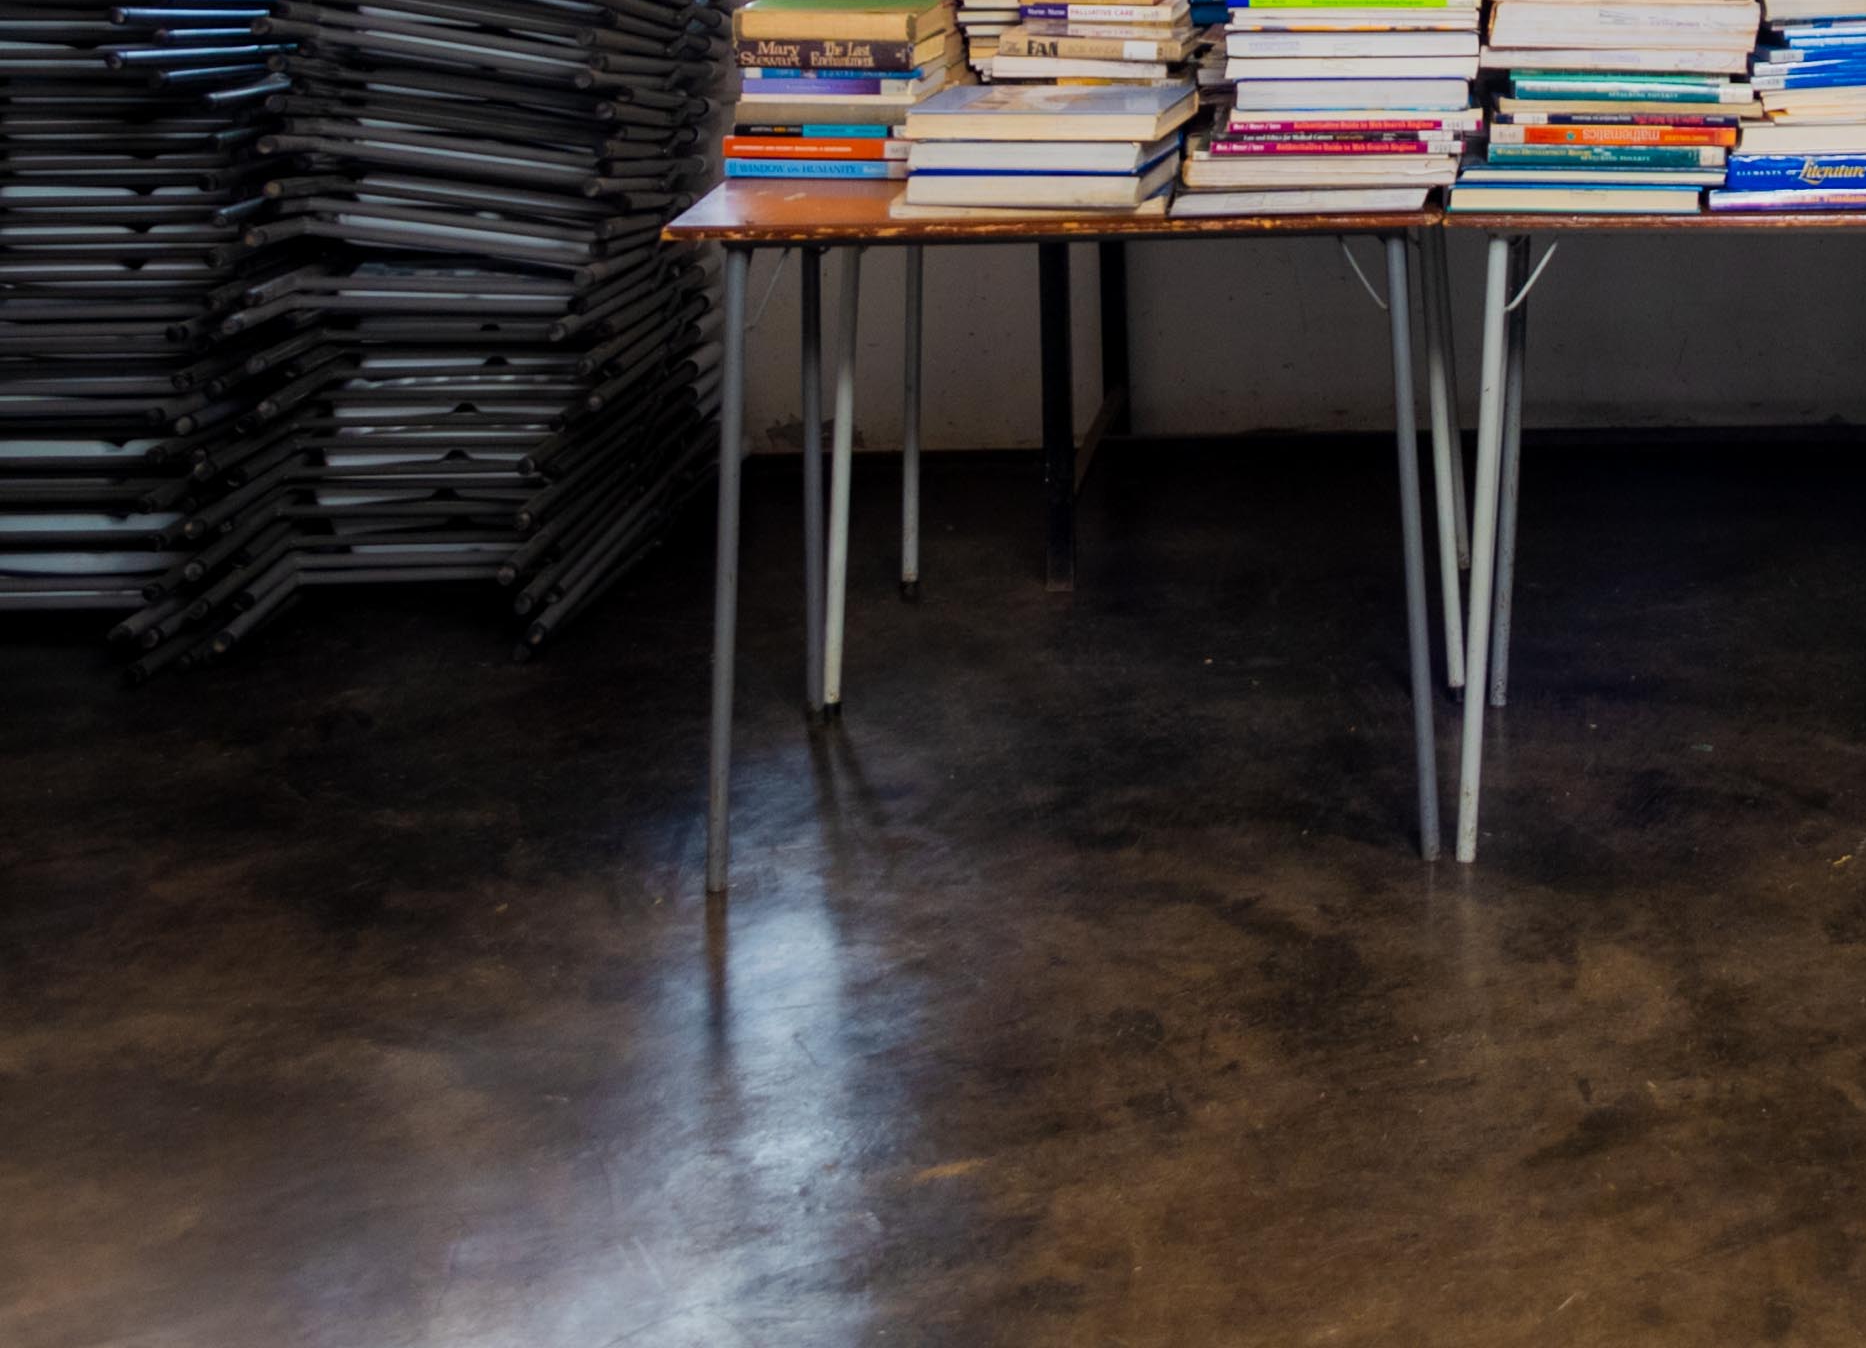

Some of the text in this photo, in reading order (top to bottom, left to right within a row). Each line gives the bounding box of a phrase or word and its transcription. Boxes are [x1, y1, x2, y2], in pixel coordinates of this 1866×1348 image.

[1114, 9, 1134, 17] CARE
[758, 42, 800, 55] Mary
[823, 42, 870, 54] The Last
[1027, 40, 1058, 57] FAN
[740, 51, 800, 66] Stewart
[810, 52, 875, 67] Enchantment
[1582, 127, 1660, 141] mathematics
[740, 163, 857, 174] WINDOW HUMANITY
[1798, 159, 1866, 185] Literature
